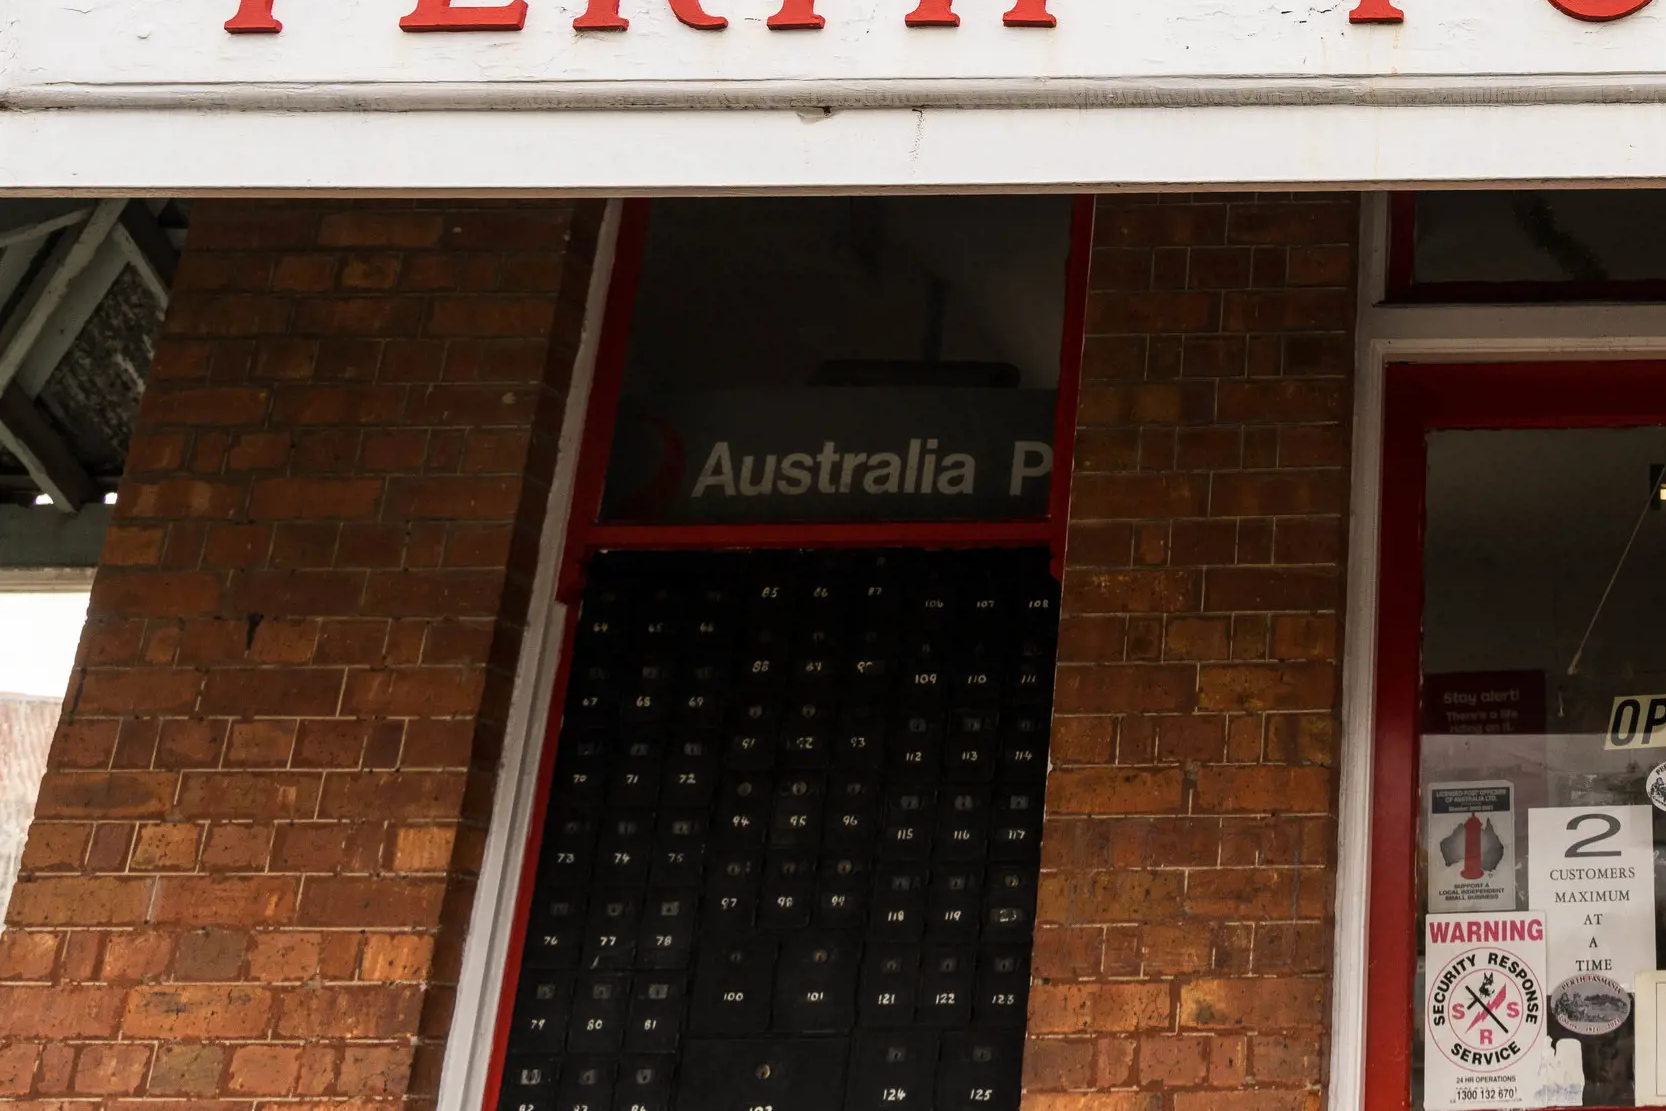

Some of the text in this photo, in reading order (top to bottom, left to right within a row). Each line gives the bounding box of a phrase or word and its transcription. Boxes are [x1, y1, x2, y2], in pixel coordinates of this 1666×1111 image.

[690, 437, 977, 499] Australia
[761, 586, 780, 599] 85
[976, 599, 995, 609] 107
[1028, 599, 1049, 609] 108
[751, 660, 770, 673] 88
[914, 673, 937, 685] 109
[967, 674, 987, 684] 110
[1020, 674, 1036, 685] 111
[582, 696, 599, 707] 67
[635, 695, 651, 708] 68
[688, 696, 704, 708] 69
[1443, 690, 1477, 705] Stay
[741, 738, 756, 750] 91
[850, 736, 866, 748] 93
[905, 751, 922, 762] 112
[961, 750, 978, 762] 113
[1014, 750, 1033, 761] 114
[573, 773, 588, 784] 70
[626, 773, 639, 784] 71
[679, 773, 697, 784] 72
[732, 815, 750, 827] 94
[789, 815, 807, 827] 95
[842, 815, 858, 826] 96
[897, 827, 914, 840] 115
[953, 829, 970, 840] 116
[1008, 829, 1026, 840] 117
[1564, 813, 1622, 858] 2
[557, 852, 575, 864] 73
[614, 852, 631, 864] 74
[667, 852, 684, 863] 75
[1549, 867, 1636, 881] CUSTOMERS
[777, 896, 793, 908] 98
[1555, 890, 1630, 903] MAXIMUM
[720, 897, 738, 910] 97
[887, 910, 905, 922] 118
[944, 910, 962, 922] 119
[1583, 913, 1603, 925] AT
[1429, 919, 1543, 944] WARNING
[543, 935, 559, 946] 76
[600, 935, 617, 946] 77
[656, 935, 673, 947] 78
[1588, 936, 1598, 948] A
[1575, 959, 1612, 972] TIME
[1433, 952, 1539, 1027] SECURITY RESPONSE
[723, 991, 744, 1002] 100
[807, 991, 824, 1002] 101
[877, 992, 896, 1005] 121
[935, 992, 955, 1005] 122
[991, 993, 1015, 1005] 123
[1452, 1001, 1520, 1020] S S
[586, 1018, 603, 1031] 80
[643, 1019, 657, 1031] 81
[1479, 1028, 1493, 1045] R
[1450, 1041, 1521, 1066] SERVICE
[1475, 1075, 1516, 1083] OPERATIONS
[882, 1088, 907, 1101] 124
[970, 1088, 993, 1101] 125
[1457, 1089, 1514, 1100] 1300 132 670
